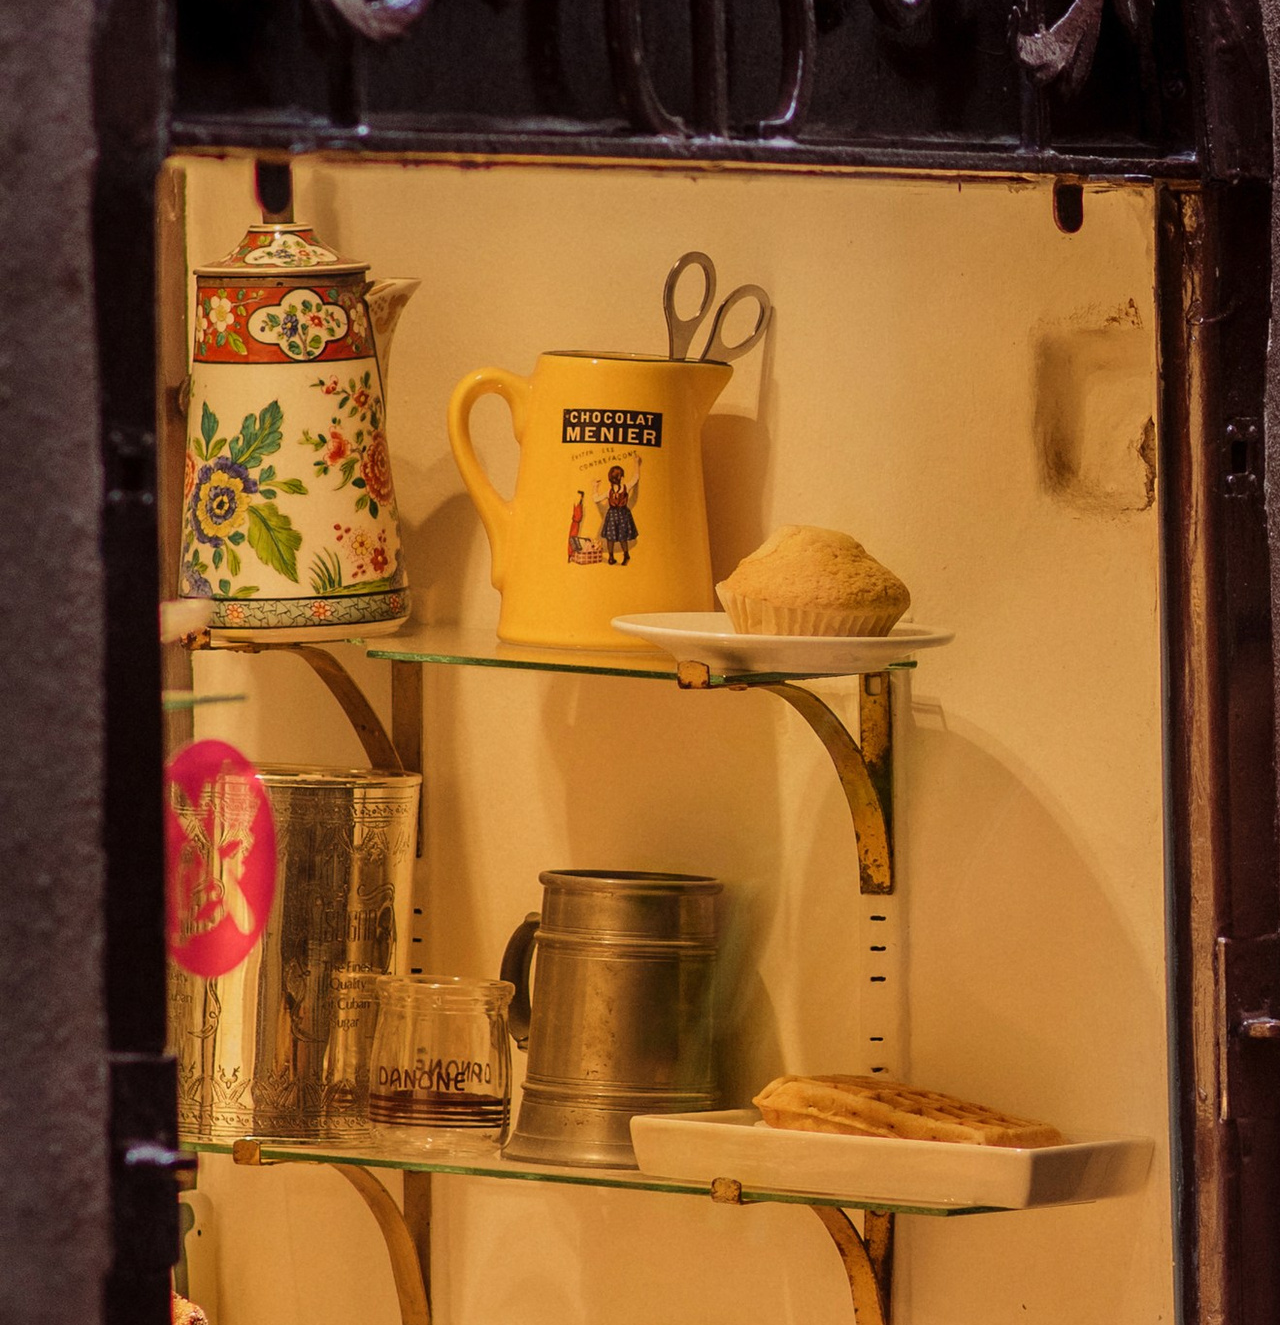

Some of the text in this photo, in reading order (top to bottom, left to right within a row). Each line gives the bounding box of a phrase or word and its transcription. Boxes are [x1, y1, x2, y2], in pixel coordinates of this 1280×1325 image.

[570, 411, 654, 426] CHOCOLAT
[566, 426, 656, 445] MENIER
[346, 961, 373, 973] Finest
[330, 978, 367, 991] Quality
[337, 997, 371, 1010] Cuban
[330, 1018, 360, 1032] Sugar
[379, 1065, 466, 1091] DANONE
